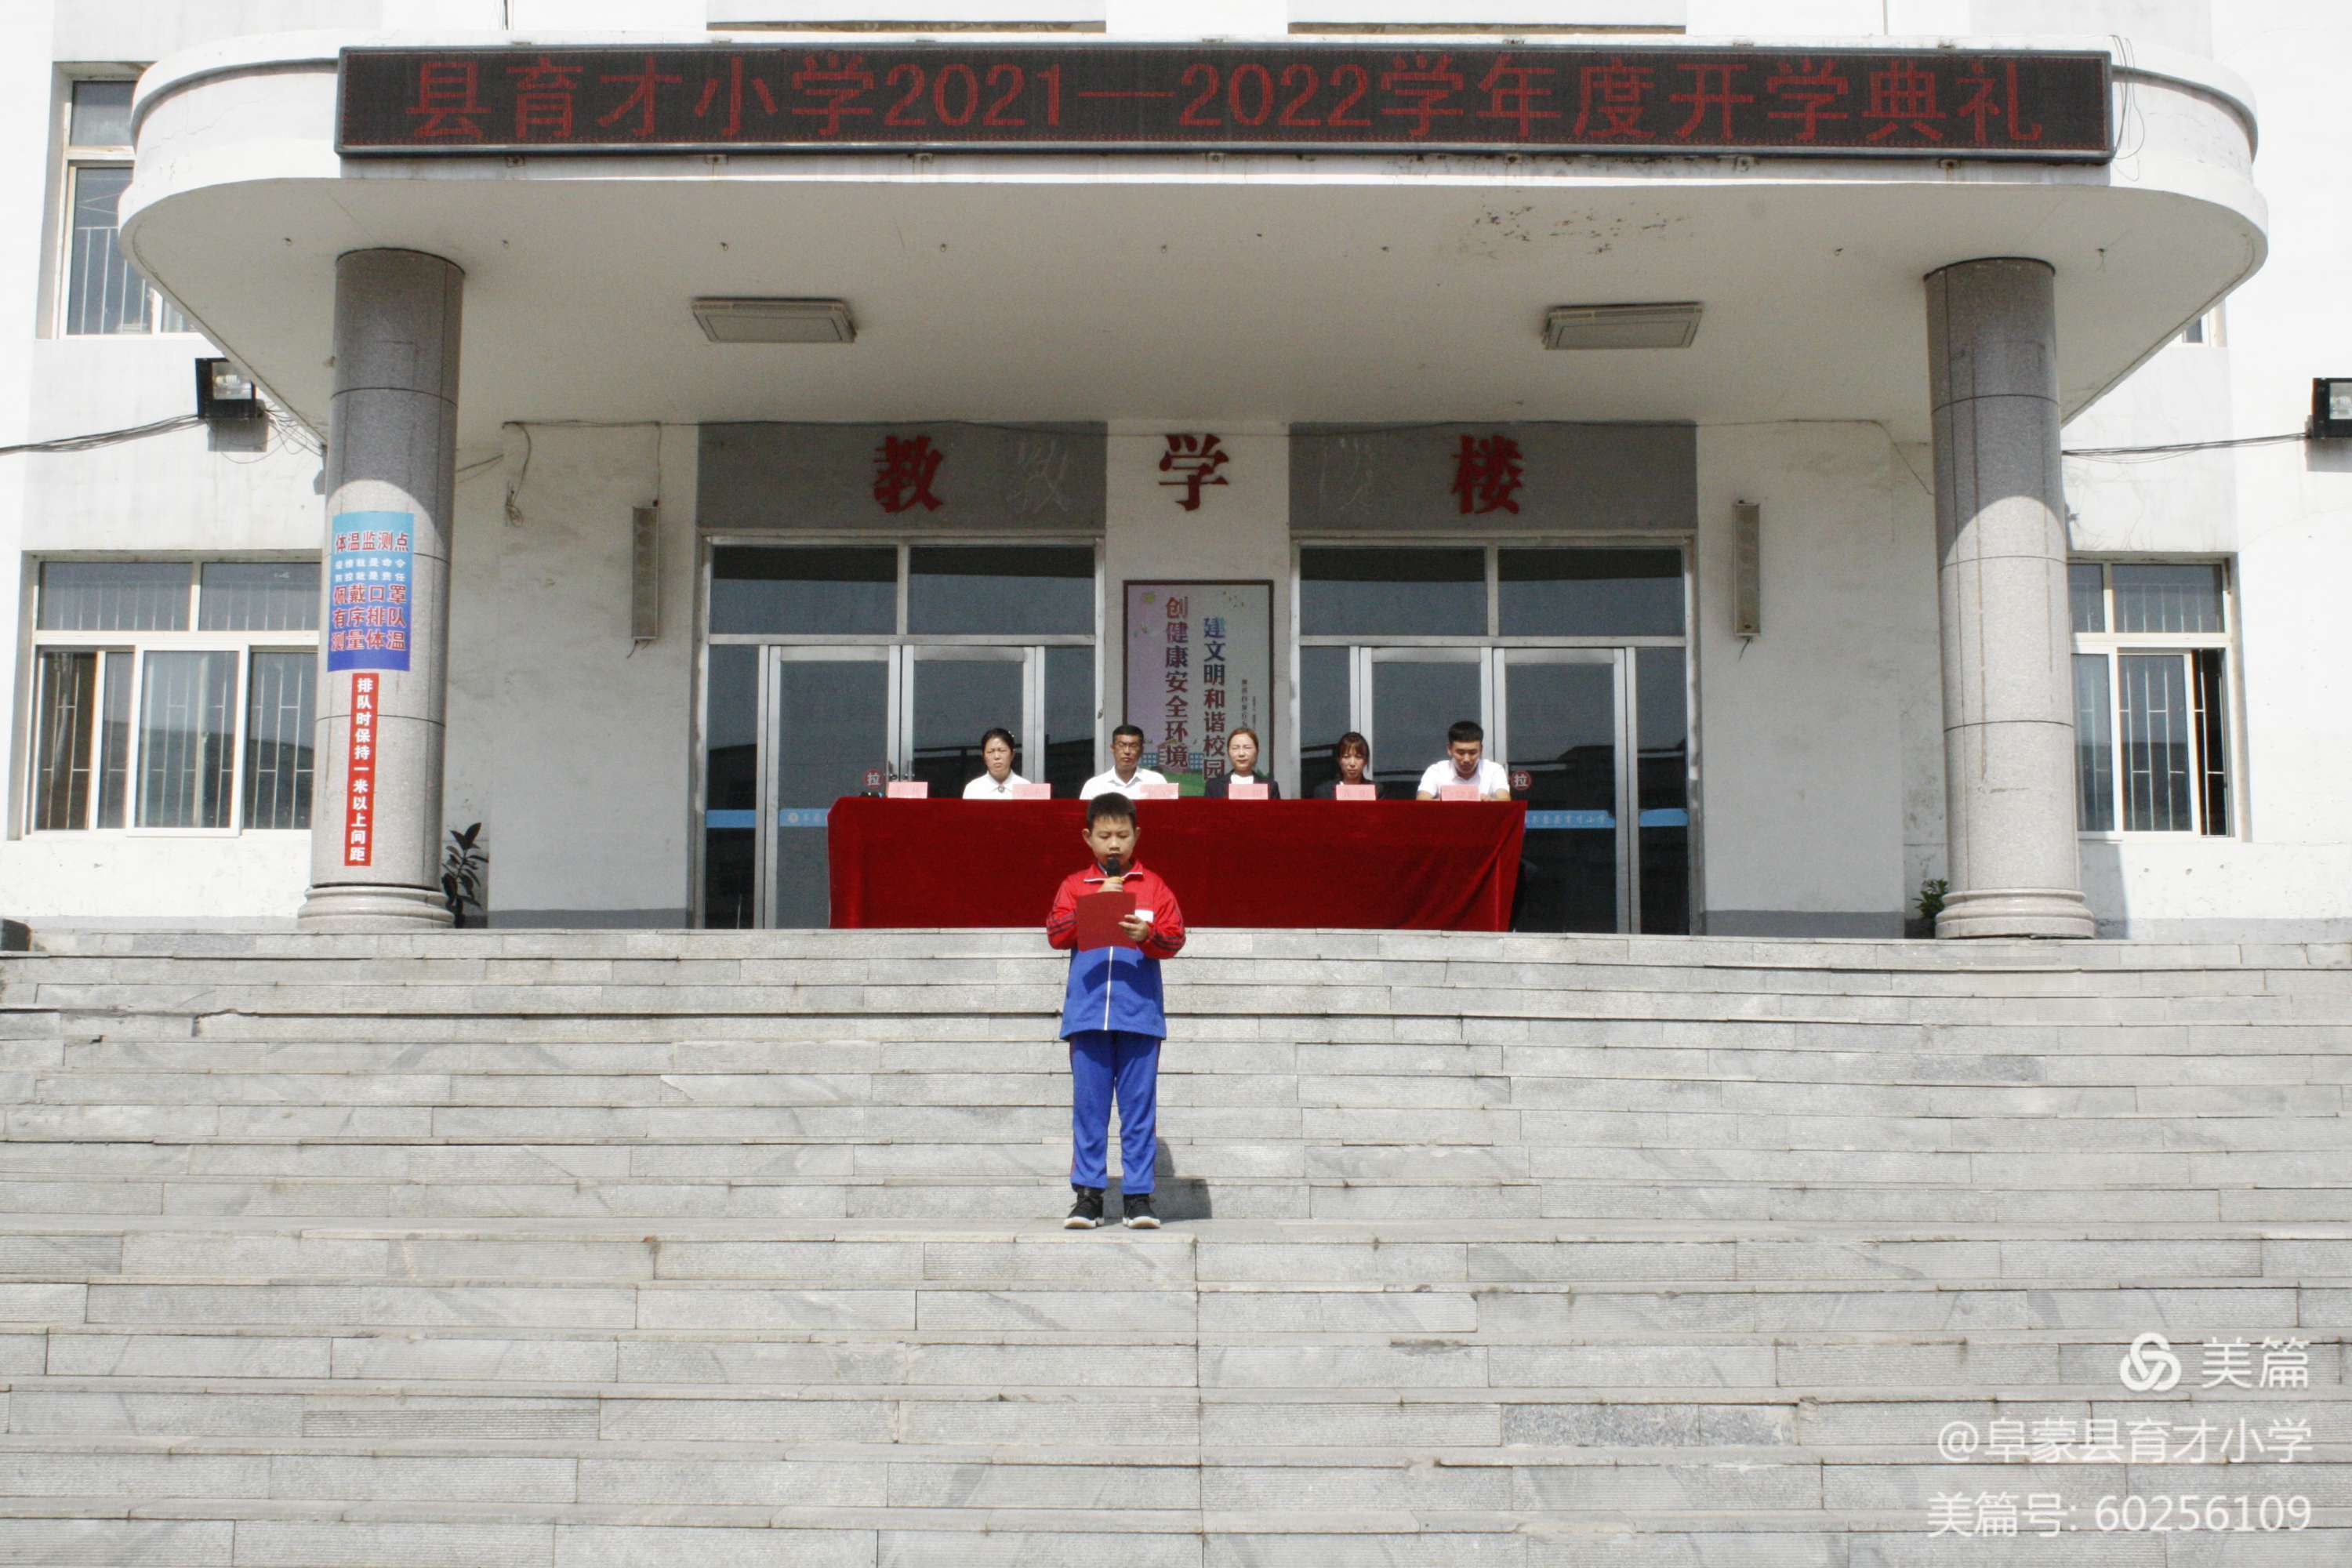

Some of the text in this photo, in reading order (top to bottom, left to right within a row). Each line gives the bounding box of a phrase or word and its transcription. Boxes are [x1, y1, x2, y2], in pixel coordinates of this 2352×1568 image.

[335, 531, 409, 553] 体温监测点
[333, 583, 407, 604] 佩戴口罩
[332, 606, 406, 628] 有序排队
[330, 628, 406, 652] 测量体温
[1165, 596, 1189, 768] 创健康安全环境
[1203, 617, 1225, 780] 建文明和谐校园
[350, 677, 372, 862] 排队时保持一米以上间距
[1514, 773, 1529, 789] 拉
